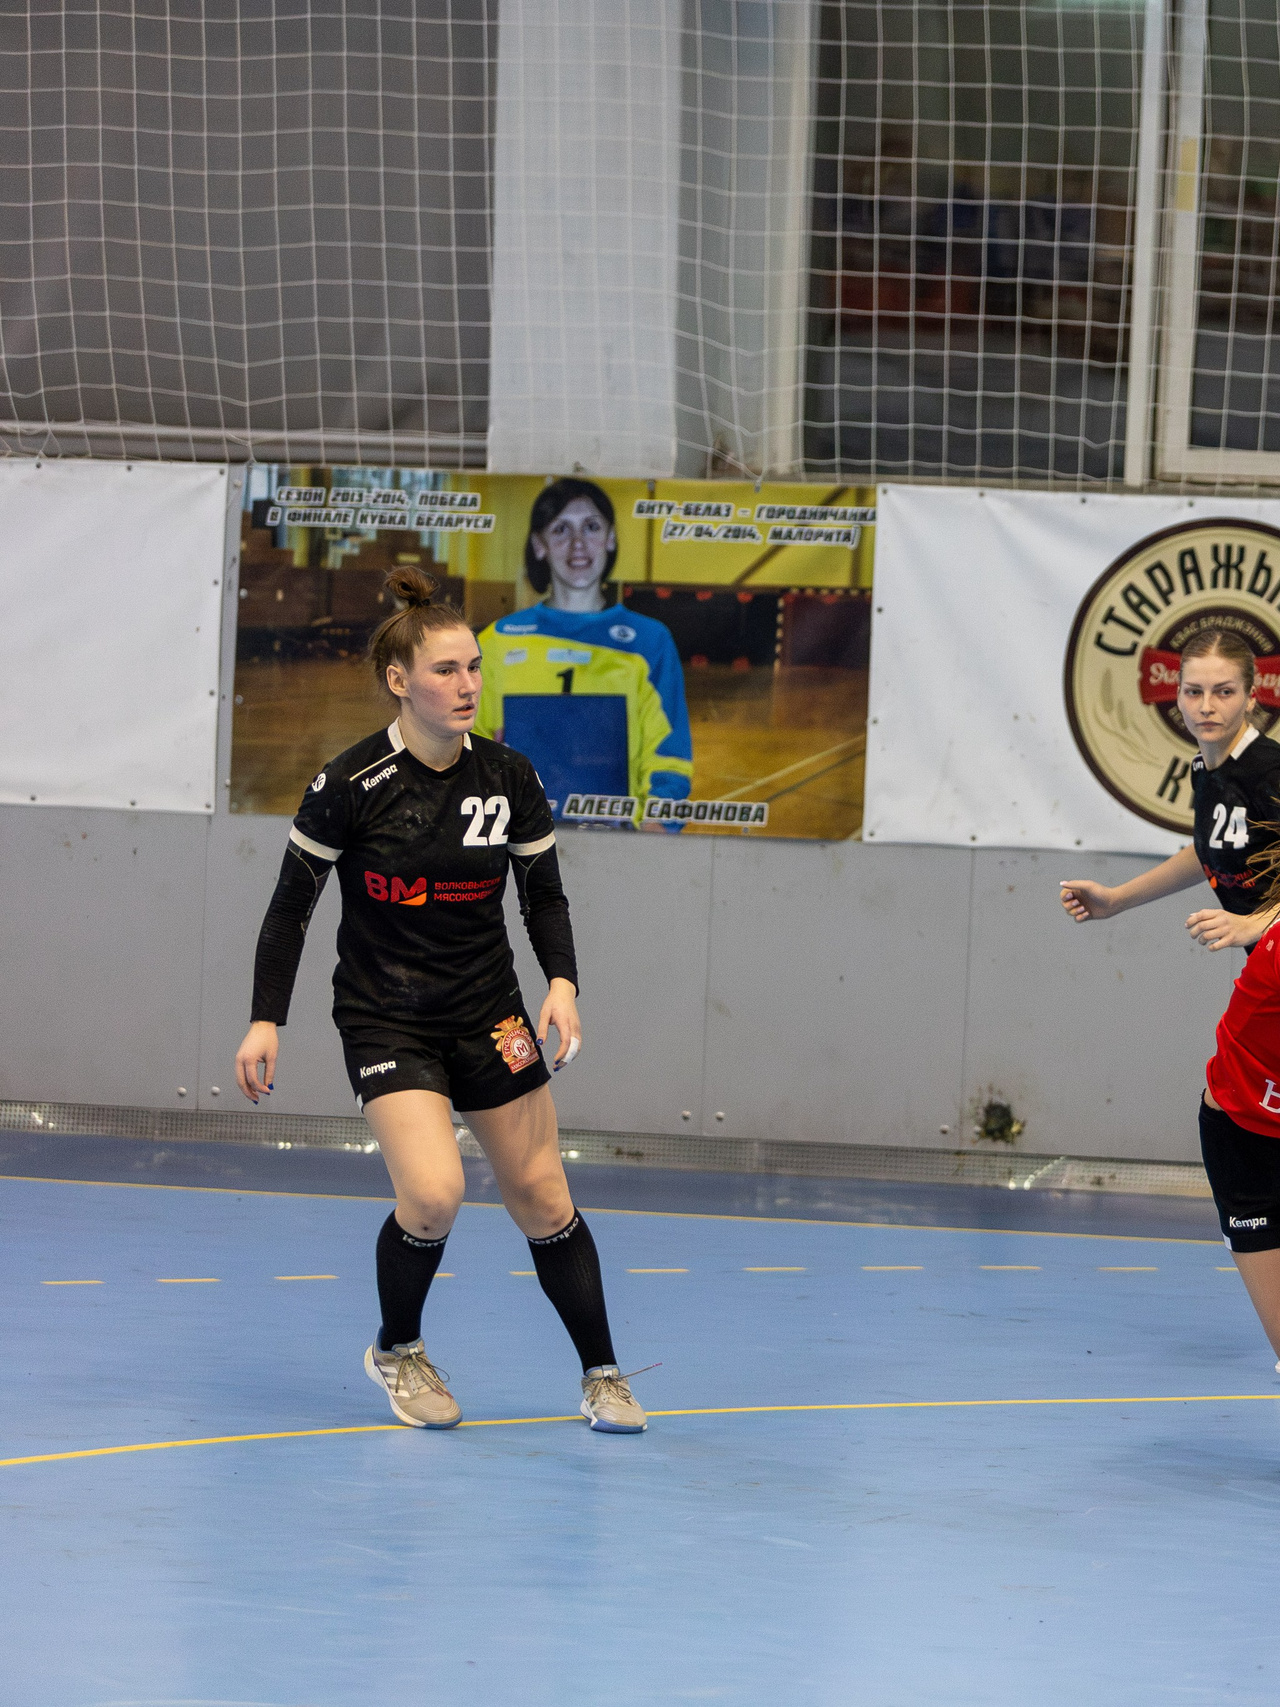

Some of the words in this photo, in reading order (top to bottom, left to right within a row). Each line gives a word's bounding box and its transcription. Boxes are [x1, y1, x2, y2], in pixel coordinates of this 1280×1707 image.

[276, 489, 325, 503] СЕЗОН
[417, 492, 480, 509] ПОБЕДА
[286, 510, 353, 526] ФИНАЛЕ
[358, 511, 408, 528] КУБКА
[414, 514, 494, 530] БЕЛАРУСИ
[556, 667, 575, 694] 1
[361, 763, 399, 792] Kempa
[460, 795, 512, 847] 22
[564, 796, 637, 818] АЛЕСЯ
[646, 798, 766, 824] САФОНОВА
[1208, 802, 1250, 850] 24
[359, 1060, 397, 1080] Kempa
[1228, 1215, 1267, 1230] Kempa
